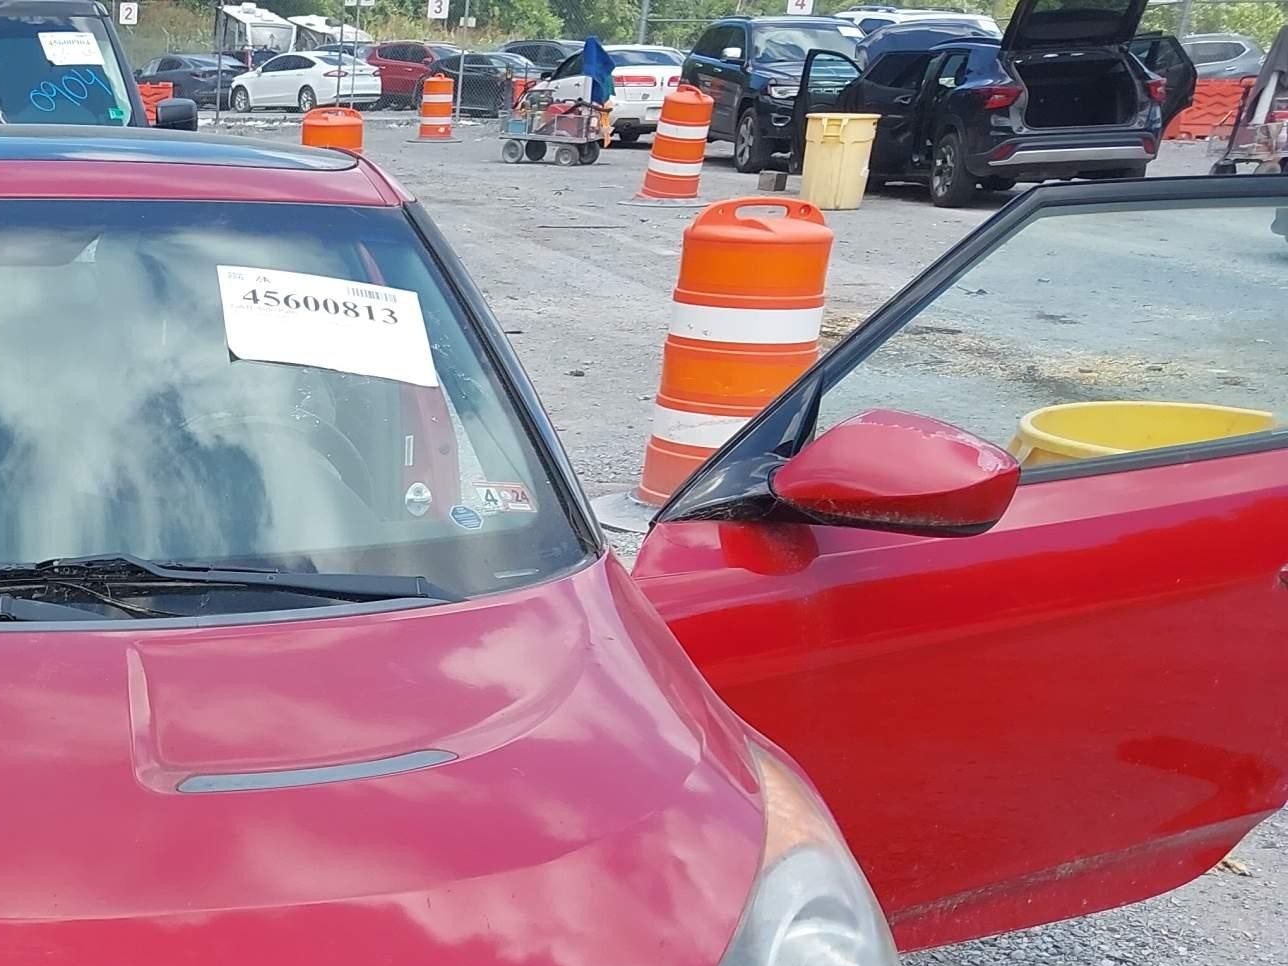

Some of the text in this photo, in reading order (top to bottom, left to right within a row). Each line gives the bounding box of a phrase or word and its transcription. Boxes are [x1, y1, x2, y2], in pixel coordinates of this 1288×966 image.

[434, 0, 443, 14] 3
[795, 0, 806, 9] 4
[124, 7, 133, 20] 2
[30, 69, 112, 112] 0904
[242, 288, 399, 325] 45600813
[485, 489, 498, 505] 4
